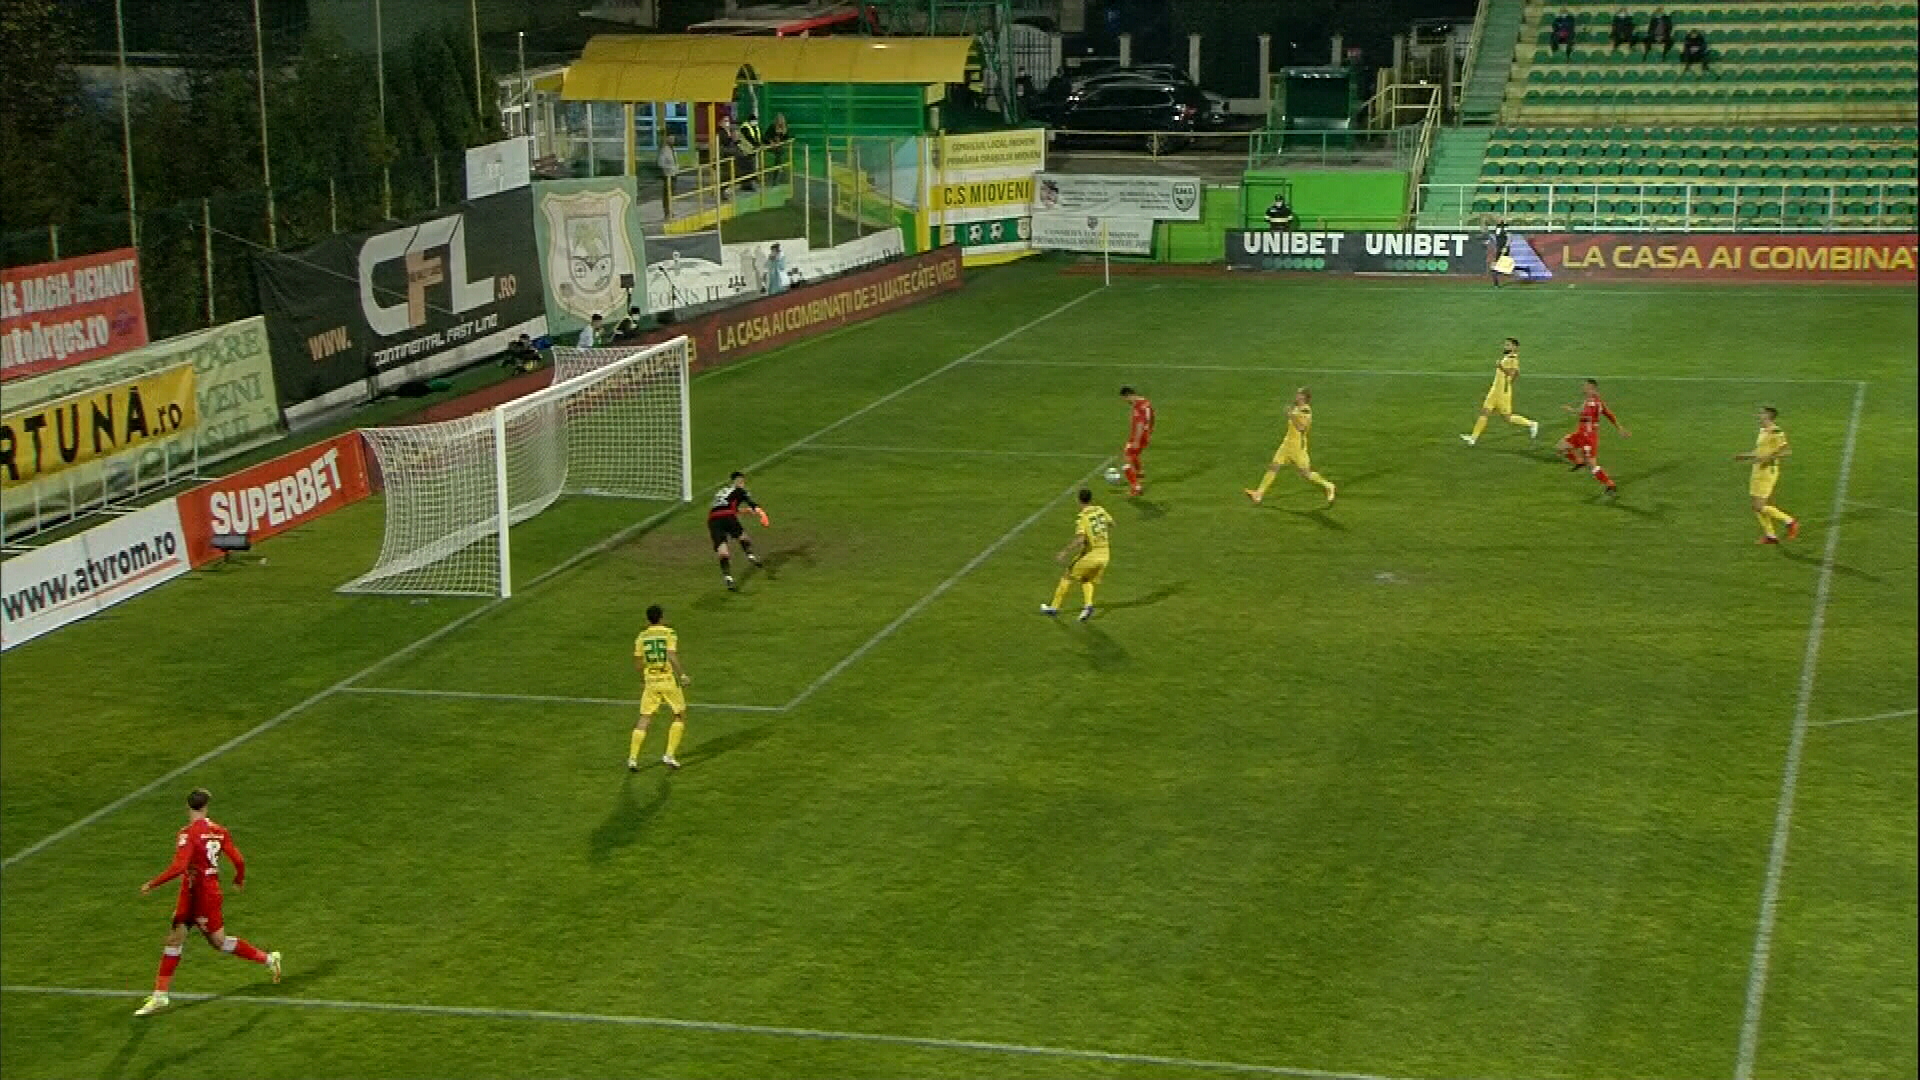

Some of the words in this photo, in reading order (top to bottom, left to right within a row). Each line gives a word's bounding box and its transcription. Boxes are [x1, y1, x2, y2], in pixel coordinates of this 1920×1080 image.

[944, 186, 966, 206] C.S
[970, 181, 1029, 204] MIOVENI
[1244, 232, 1344, 255] UNIBET
[1365, 233, 1469, 257] UNIBET
[1563, 246, 1605, 269] LA
[1612, 245, 1701, 269] CASA
[1708, 246, 1742, 269] AI
[358, 213, 495, 336] CFL
[718, 325, 737, 352] LA
[737, 316, 773, 346] CASA
[773, 311, 784, 337] AI
[854, 287, 870, 311] DE
[870, 284, 877, 306] 3
[878, 273, 910, 303] LUATE
[911, 262, 935, 292] CÂTE
[210, 447, 341, 534] SUPERBET
[3, 532, 176, 622] www.atvrom.ro
[643, 639, 666, 663] 26
